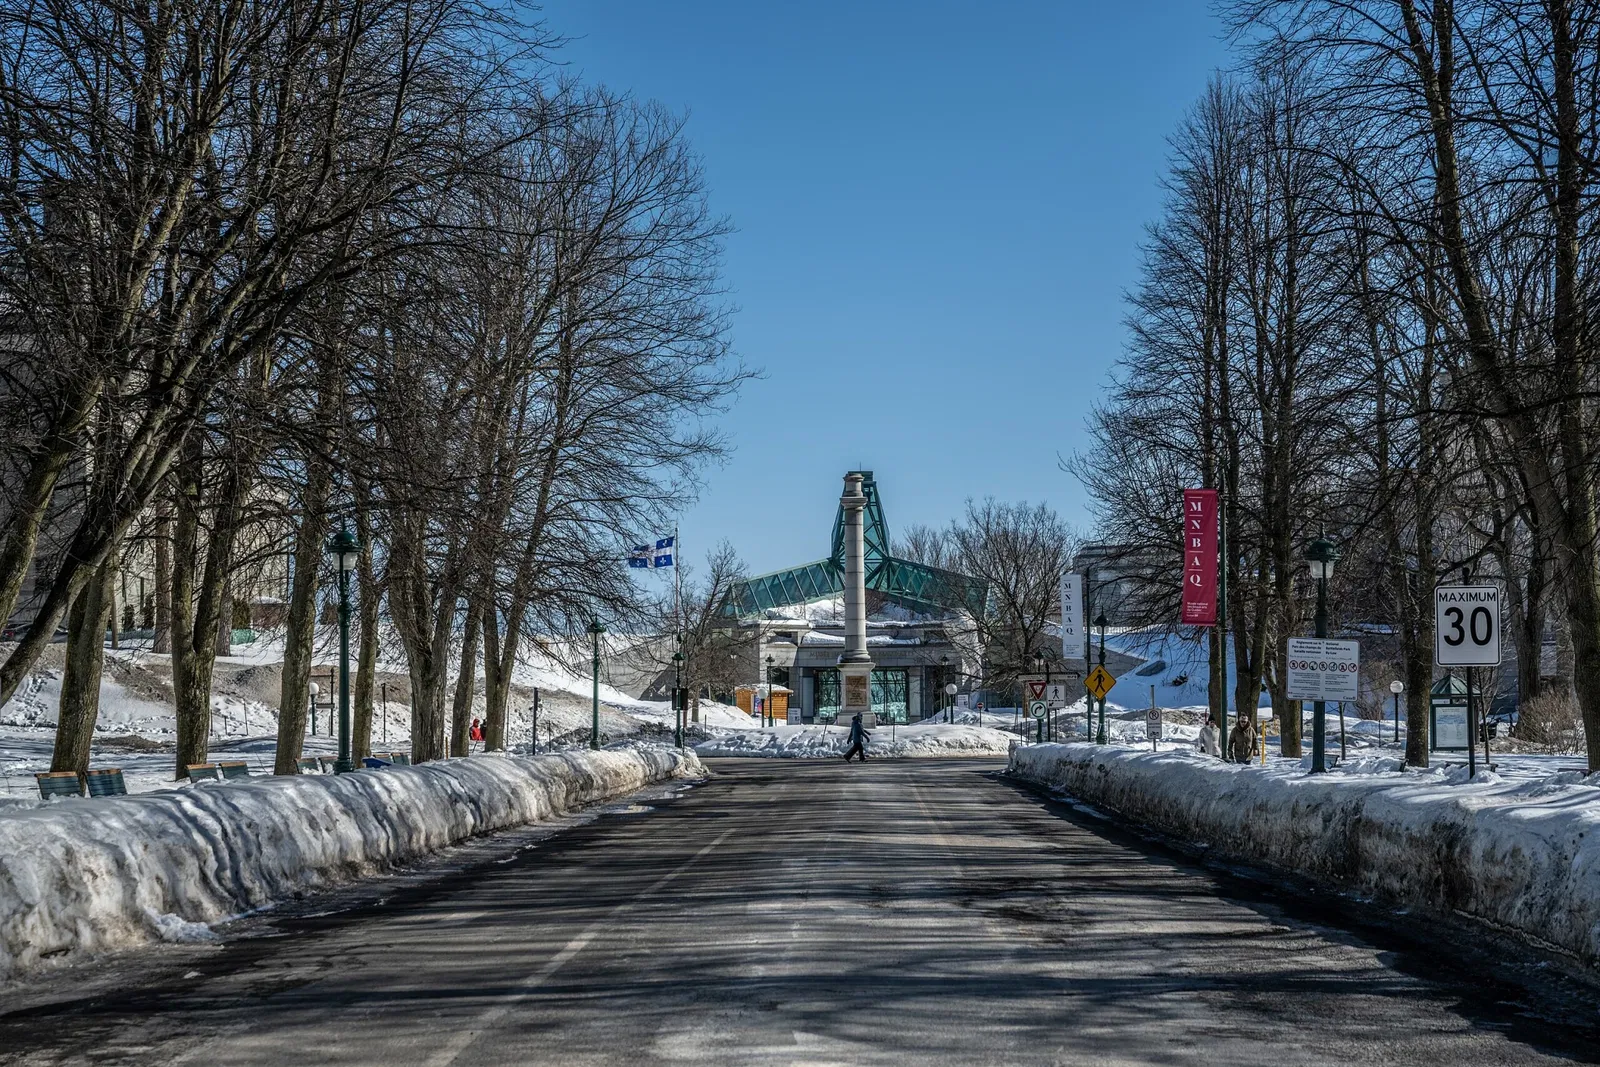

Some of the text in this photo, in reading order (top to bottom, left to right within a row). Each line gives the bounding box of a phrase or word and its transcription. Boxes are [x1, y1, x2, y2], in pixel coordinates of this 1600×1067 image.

[1190, 502, 1203, 587] MNBAQ
[1064, 583, 1074, 635] MNBAQ
[1439, 592, 1496, 602] MAXIMUM
[1444, 606, 1492, 646] 30
